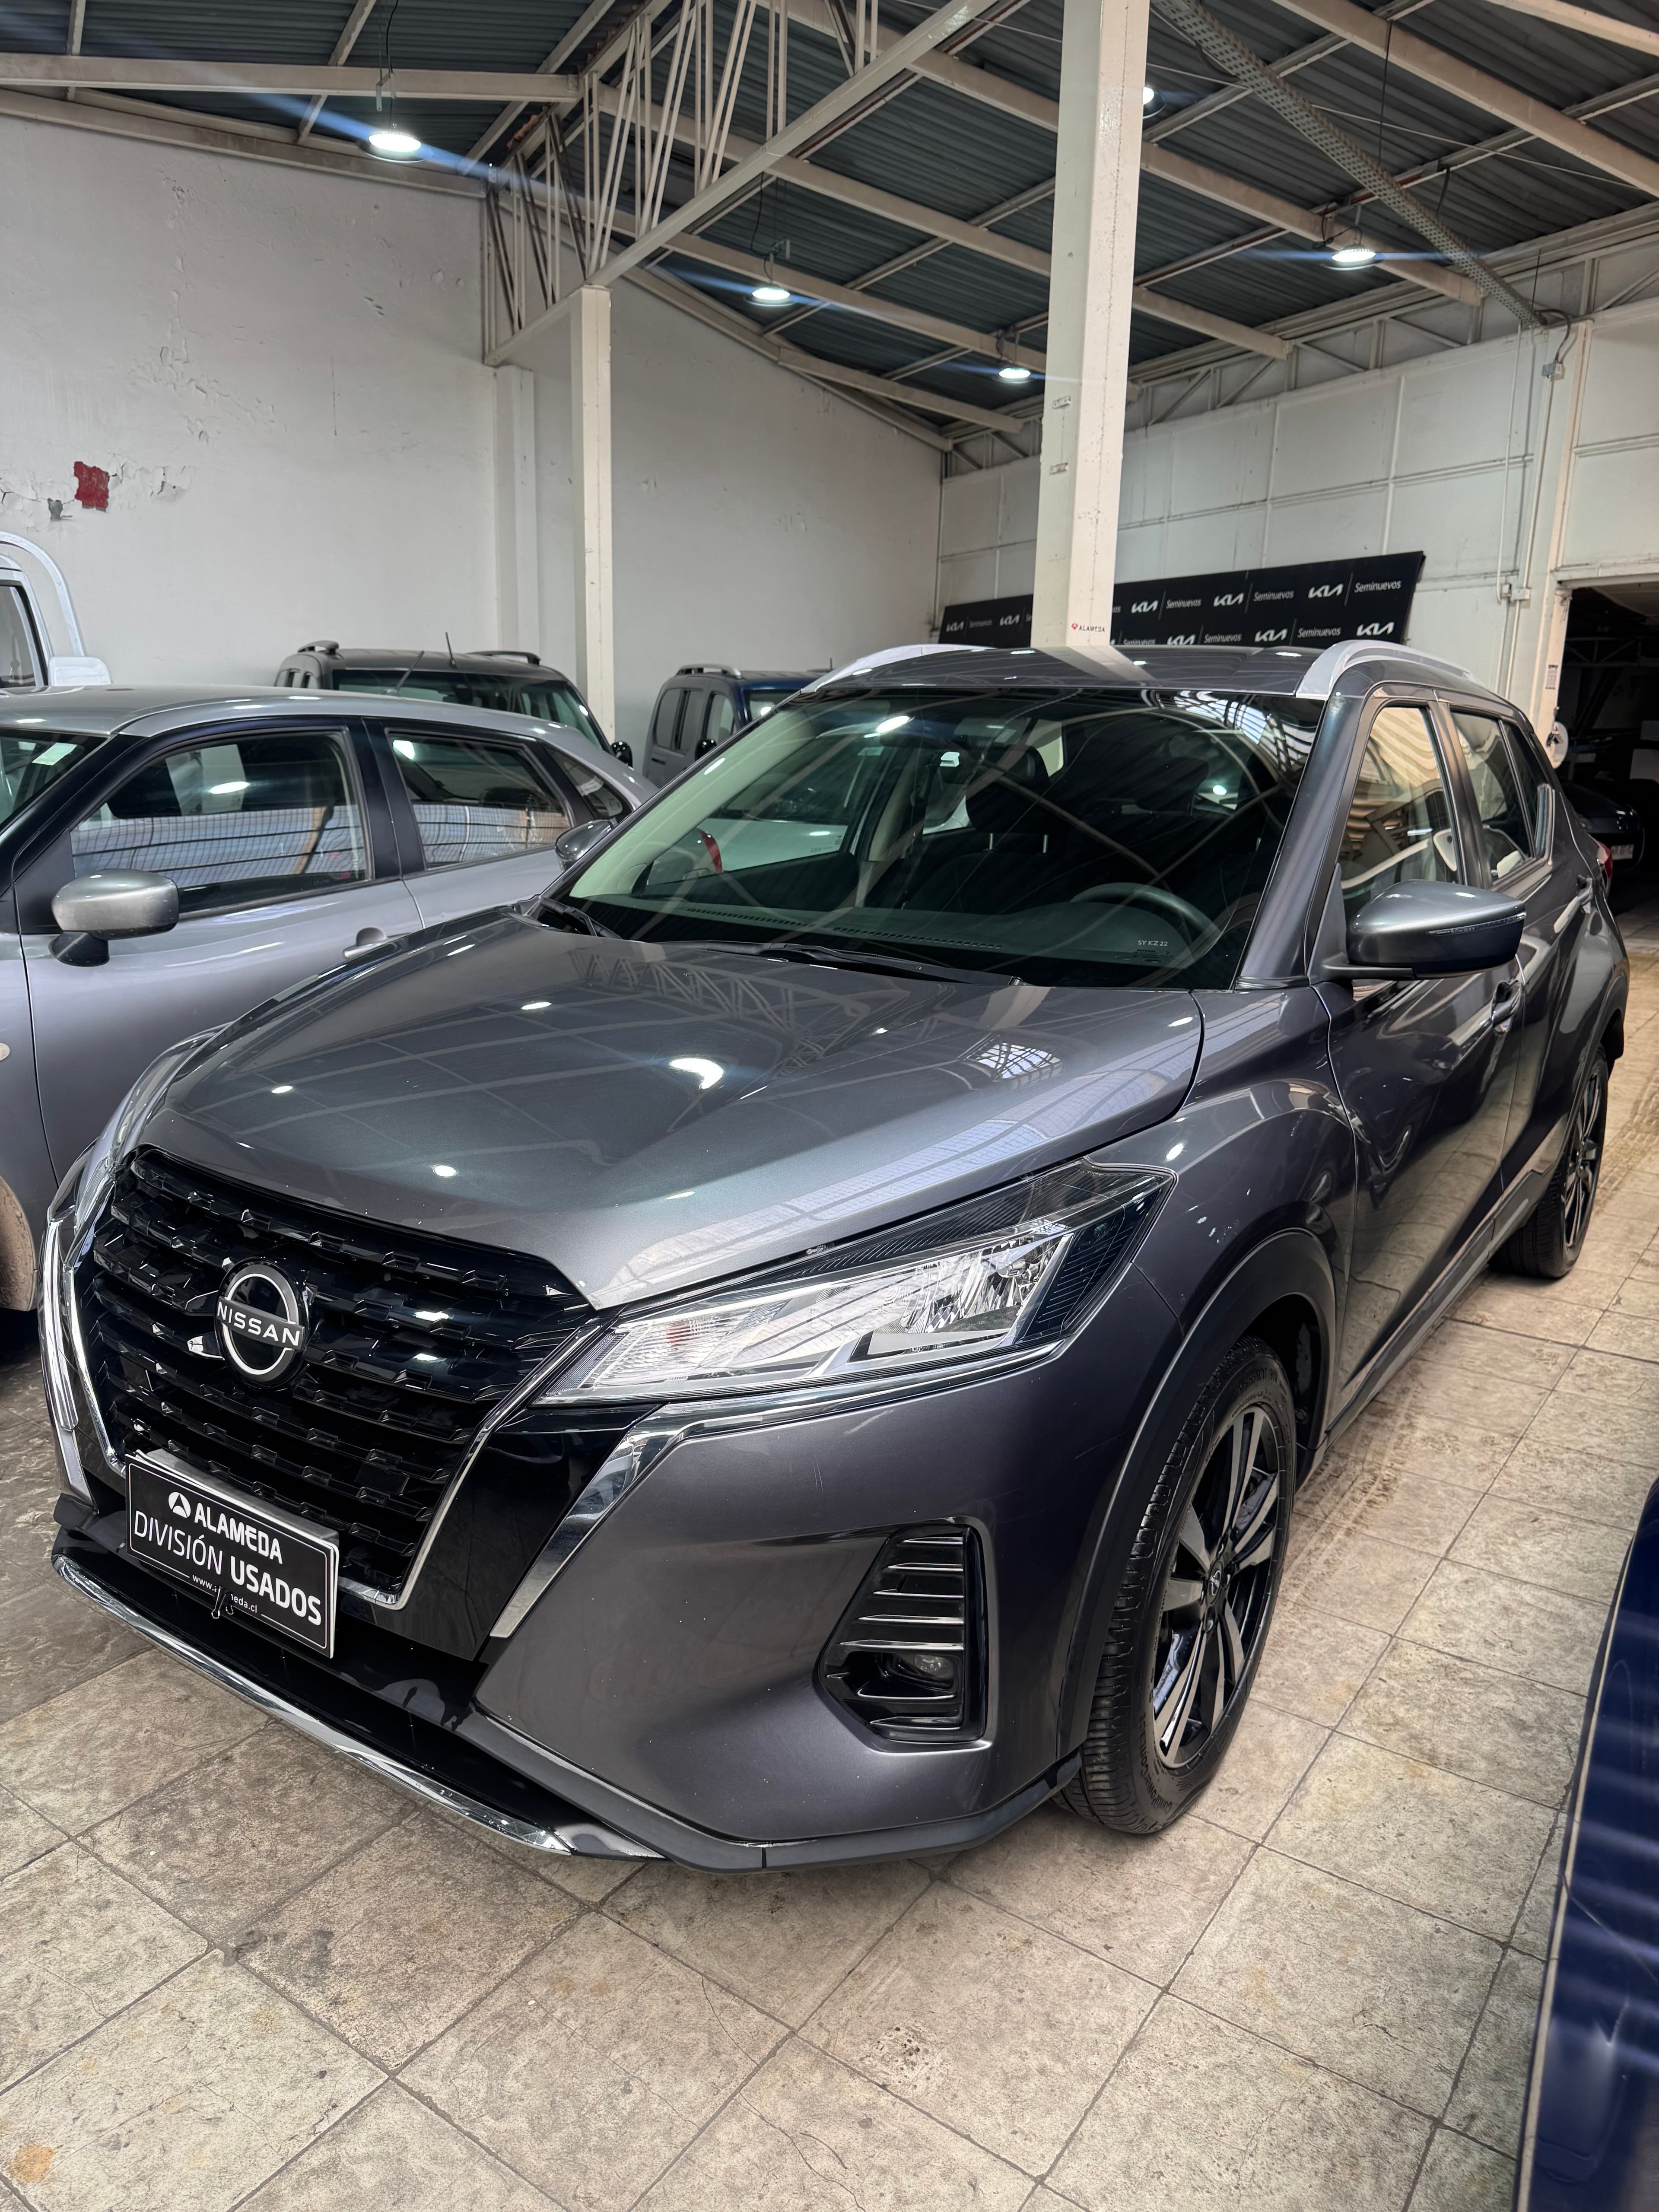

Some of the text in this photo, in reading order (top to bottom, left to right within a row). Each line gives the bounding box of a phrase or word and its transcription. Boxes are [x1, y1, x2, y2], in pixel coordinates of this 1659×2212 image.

[1354, 580, 1402, 592] Seminuevos
[1253, 590, 1294, 601] Seminuevos
[1166, 599, 1202, 609] Seminuevos
[1204, 633, 1242, 643] Seminuevos
[1297, 627, 1341, 638] Seminuevos
[217, 1301, 300, 1346] NISSAN
[194, 1503, 283, 1564] ALAMEDA
[134, 1510, 321, 1626] DIVISIÓN USADOS
[192, 1574, 257, 1614] www.eda.cl
